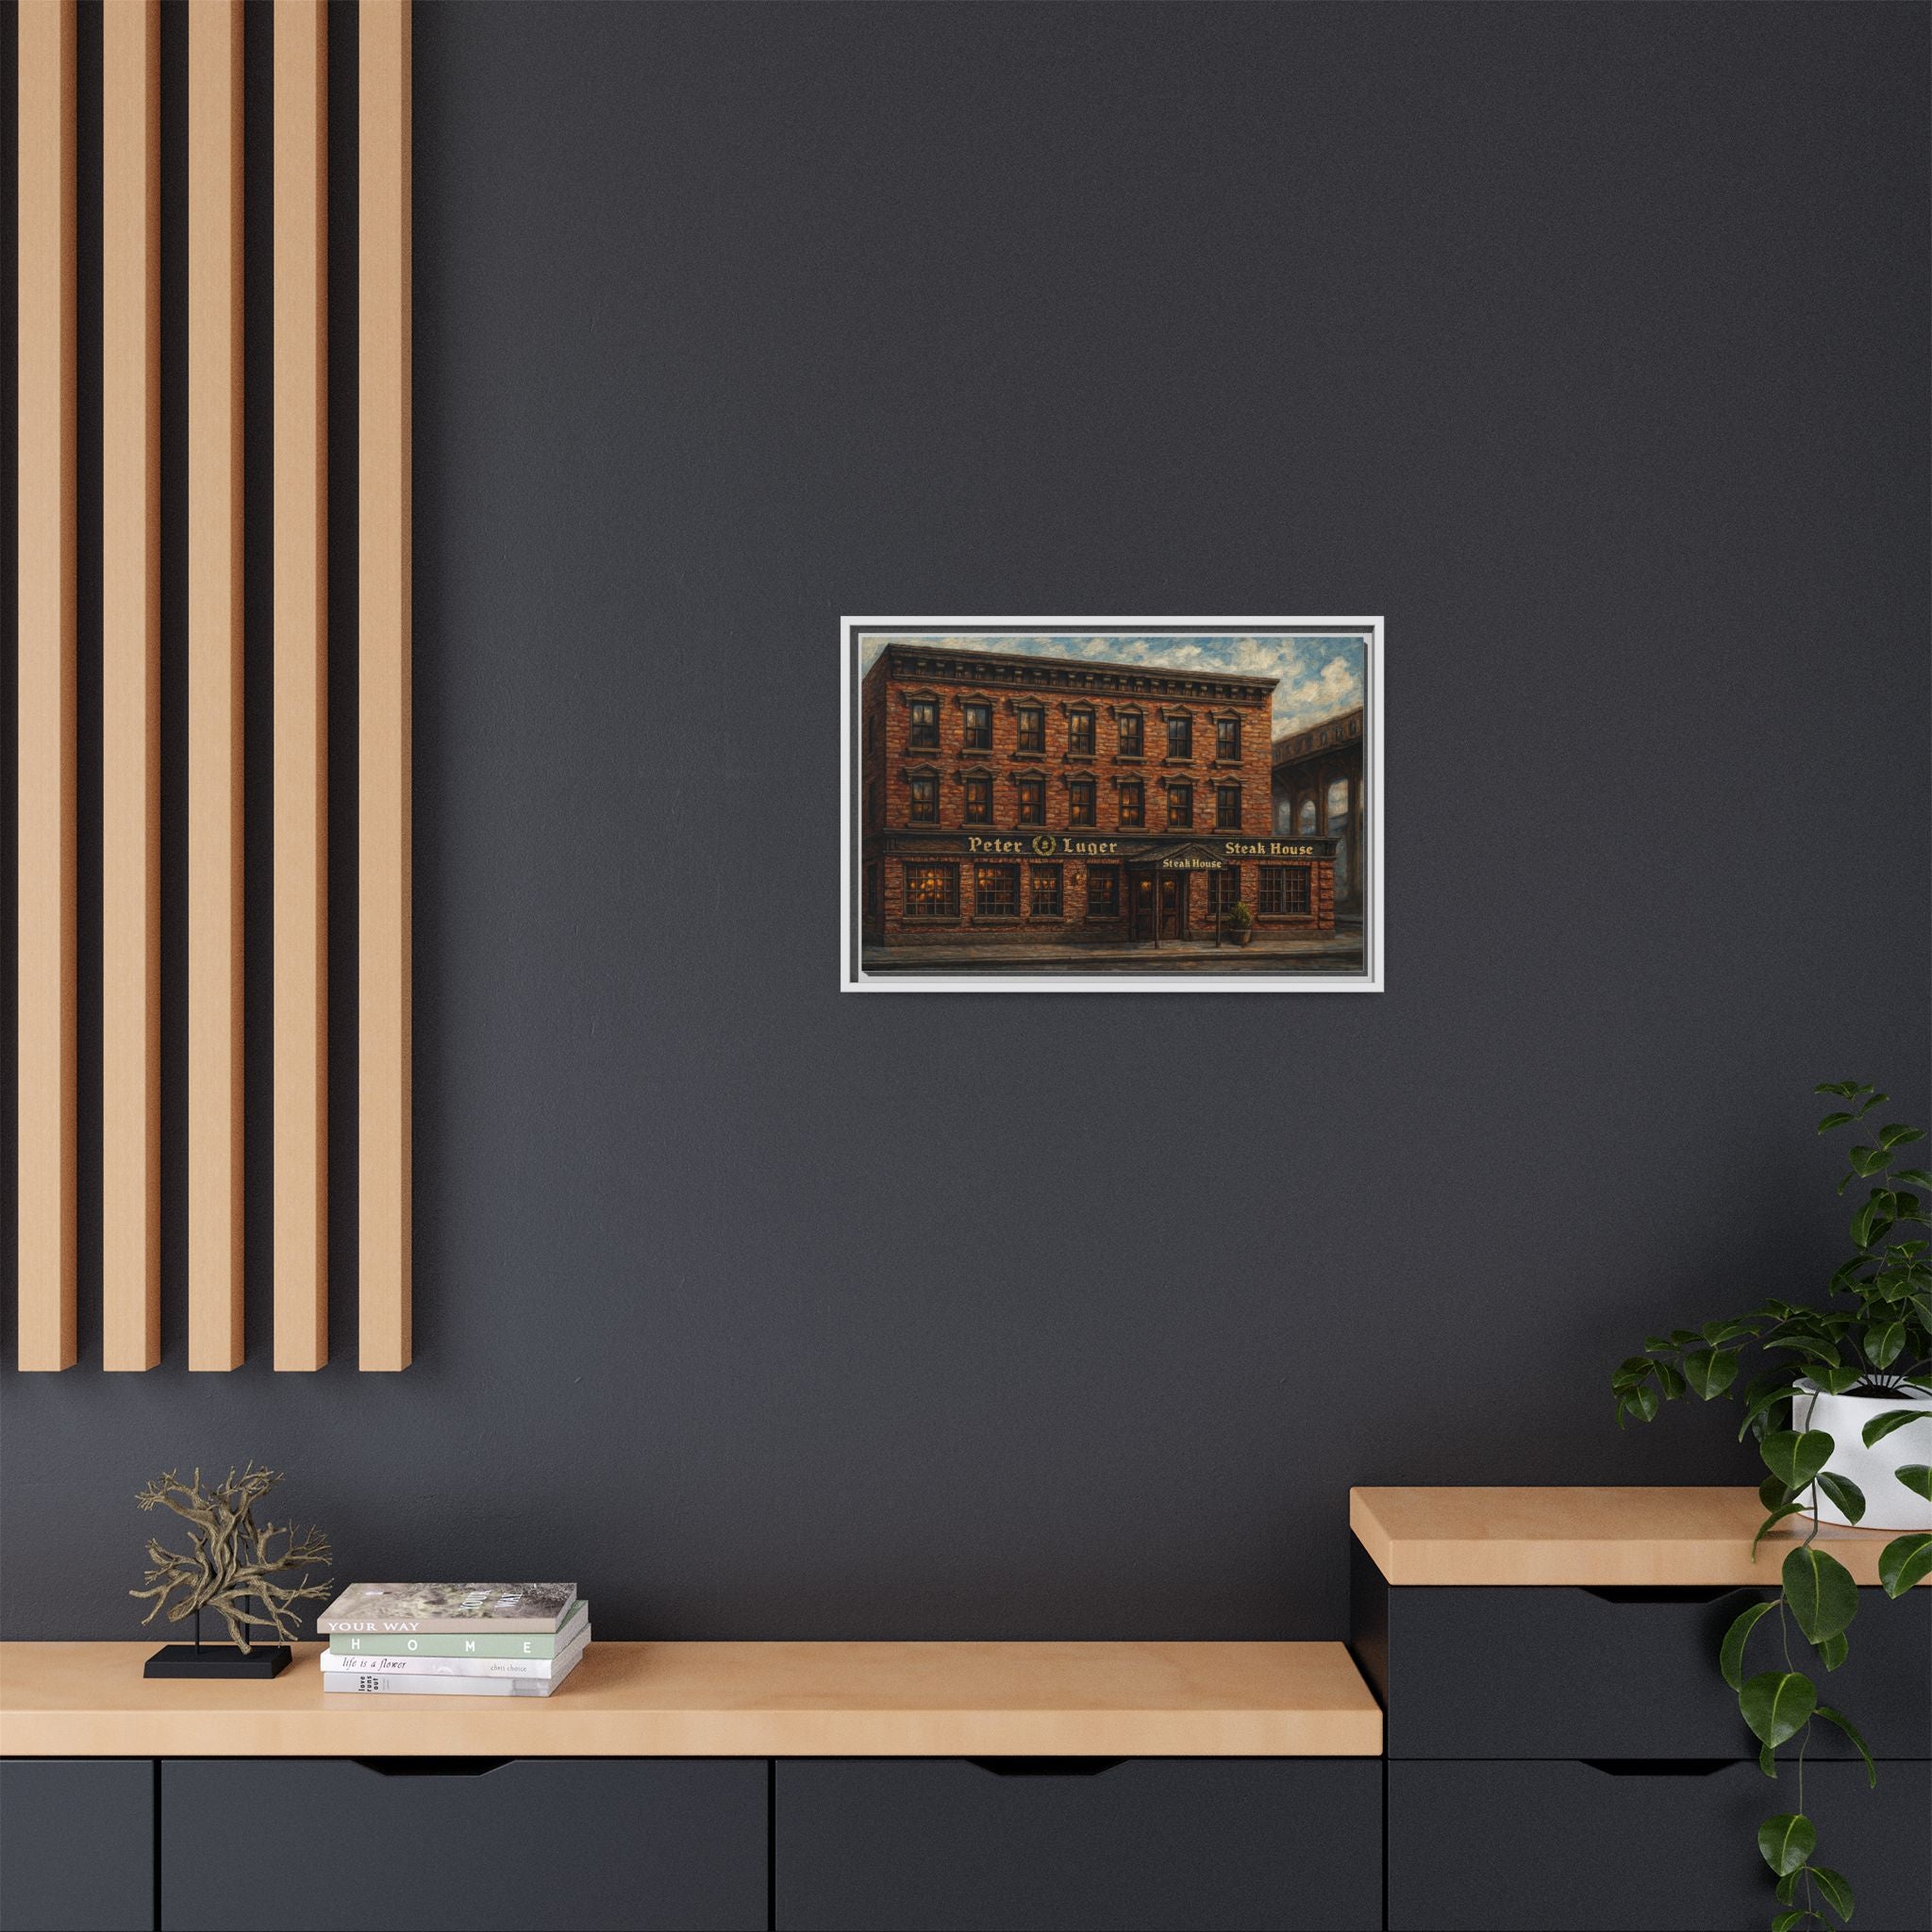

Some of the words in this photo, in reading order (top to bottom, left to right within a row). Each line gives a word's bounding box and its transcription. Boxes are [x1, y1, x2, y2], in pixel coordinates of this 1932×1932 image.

[968, 837, 1023, 853] Peter
[1062, 837, 1118, 856] Luger
[1224, 841, 1266, 855] Steak
[1270, 842, 1314, 856] House
[1162, 858, 1191, 869] Steak
[1192, 859, 1223, 869] House
[328, 1623, 376, 1631] YOUR
[383, 1623, 420, 1631] WAY
[341, 1657, 358, 1671] life
[360, 1658, 367, 1668] is
[377, 1658, 407, 1672] flower
[491, 1663, 506, 1672] chris
[507, 1664, 527, 1673] choice
